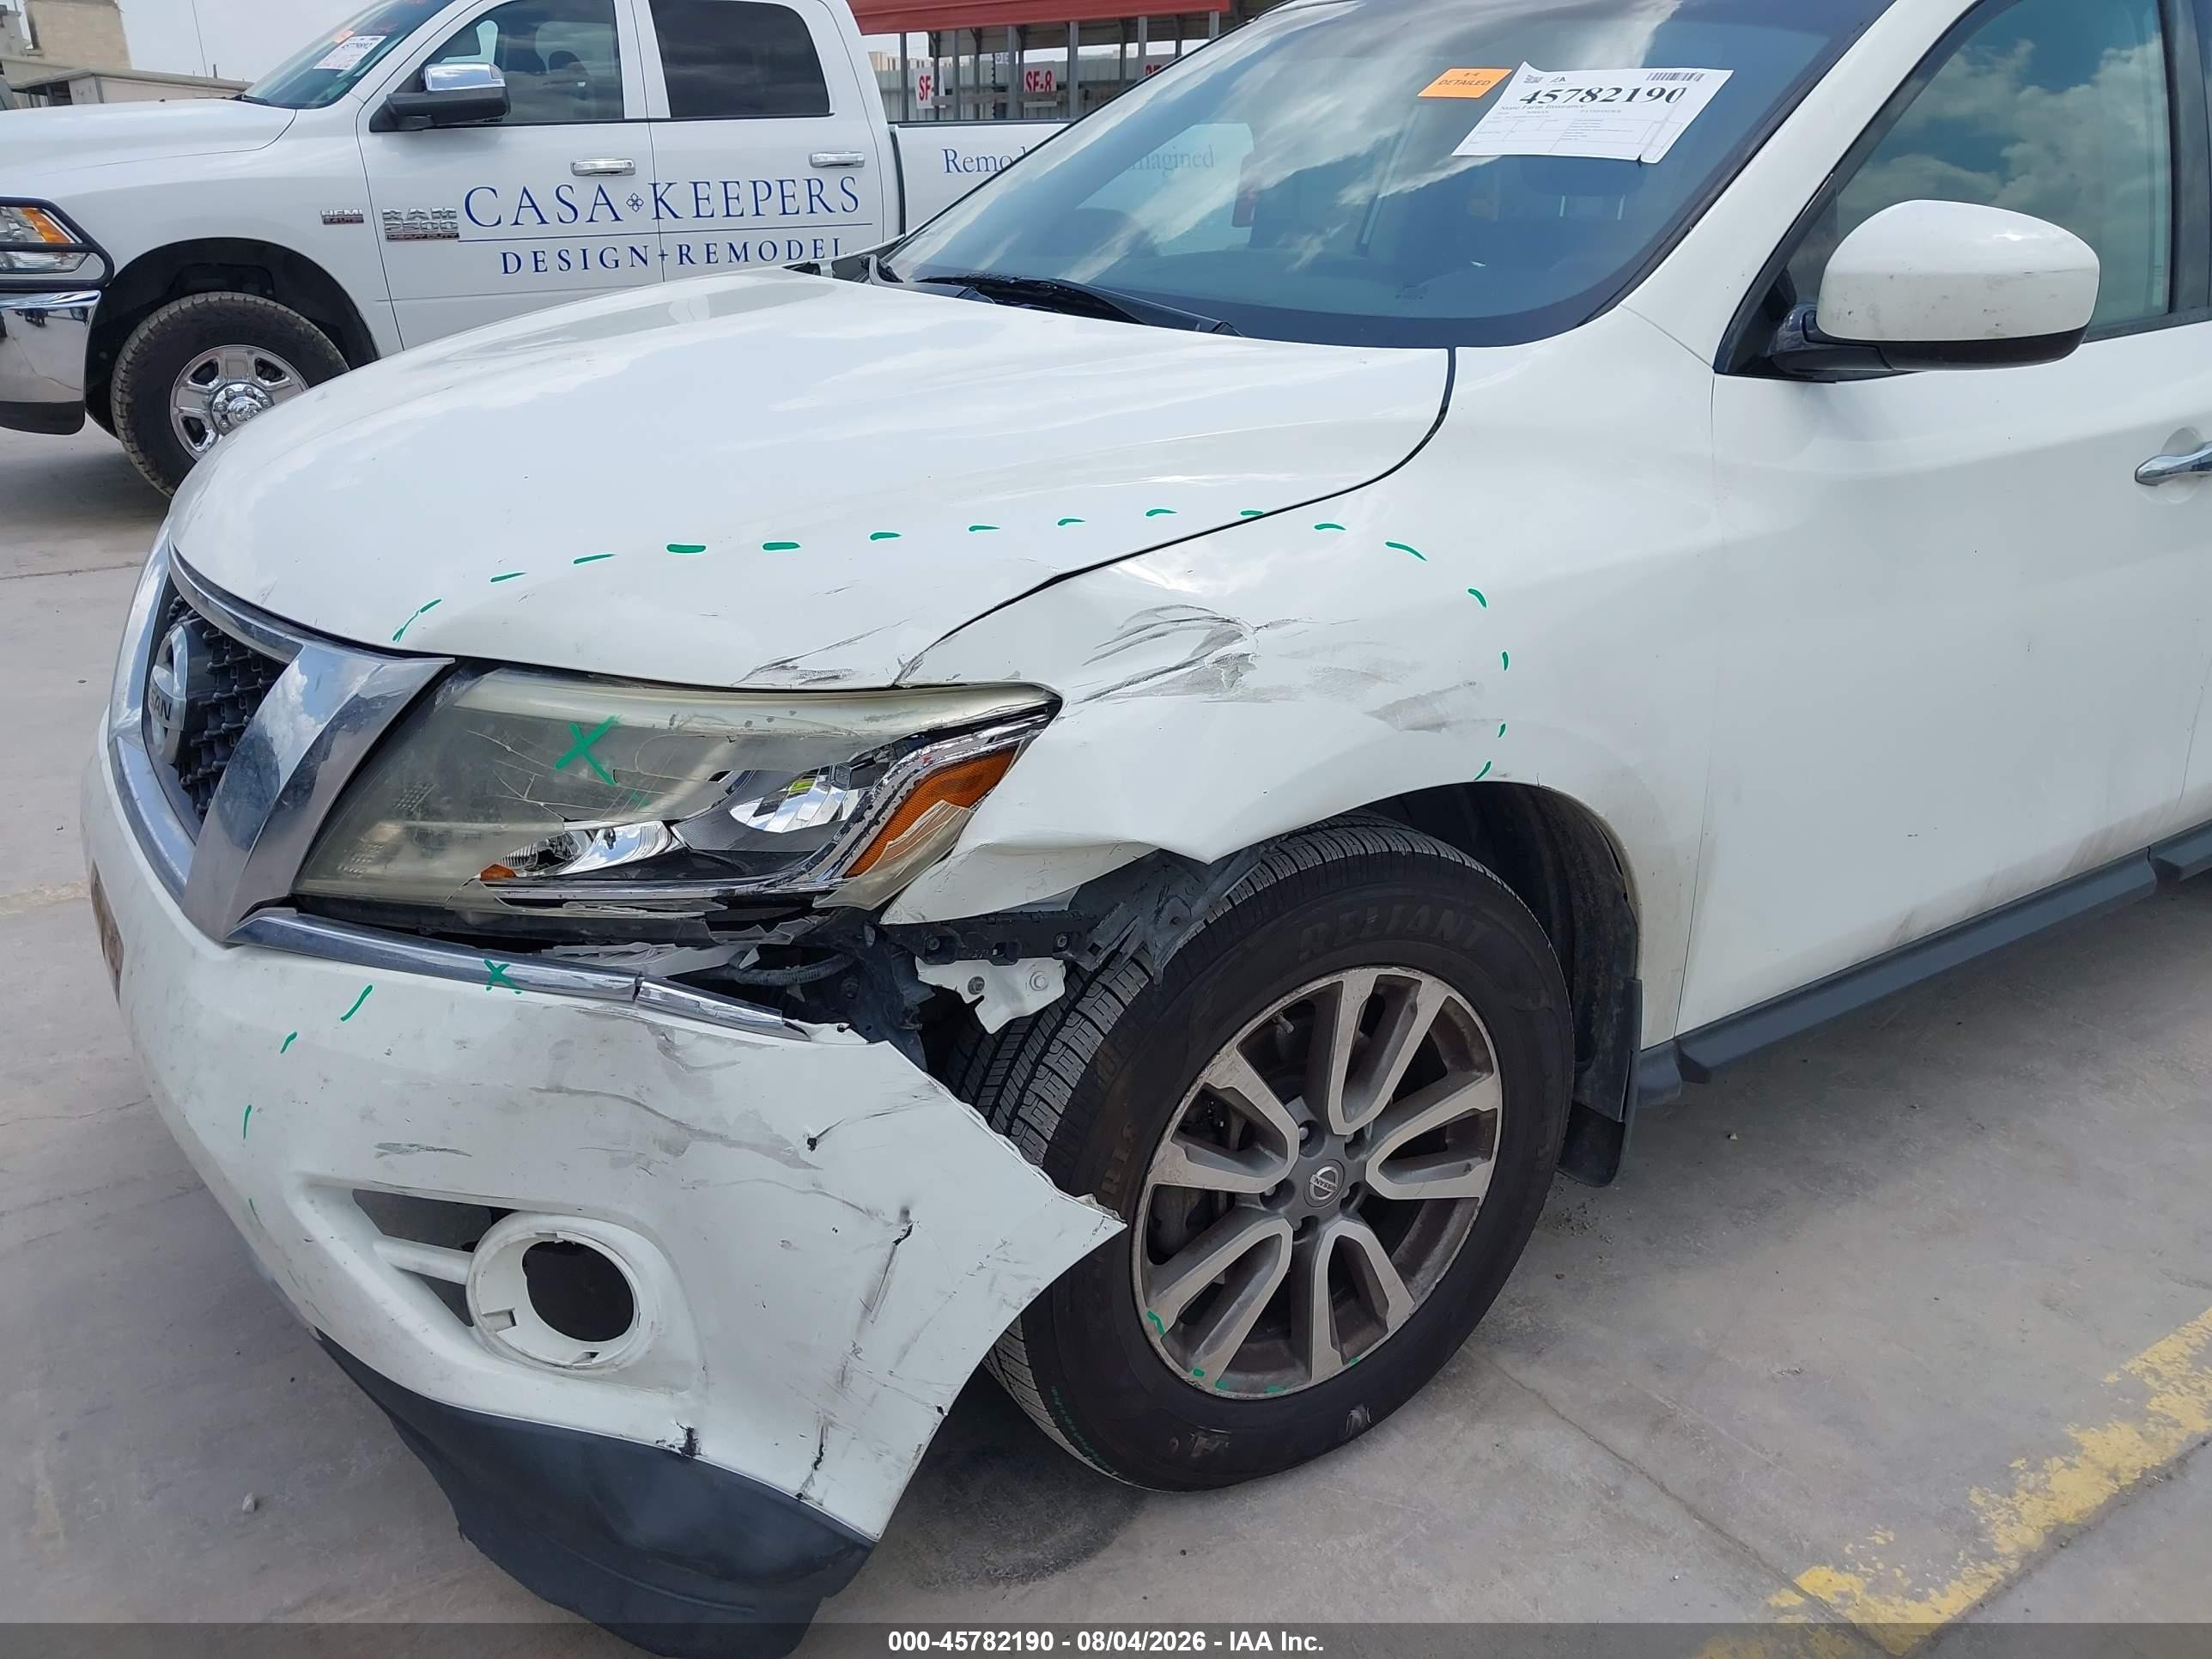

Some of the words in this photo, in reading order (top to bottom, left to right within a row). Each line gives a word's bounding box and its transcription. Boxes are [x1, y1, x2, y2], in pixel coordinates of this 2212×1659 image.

[1519, 87, 1687, 104] 45782190
[464, 183, 624, 228] CASA
[647, 175, 860, 221] KEEPERS
[382, 207, 457, 221] RAM
[383, 220, 458, 234] 2500
